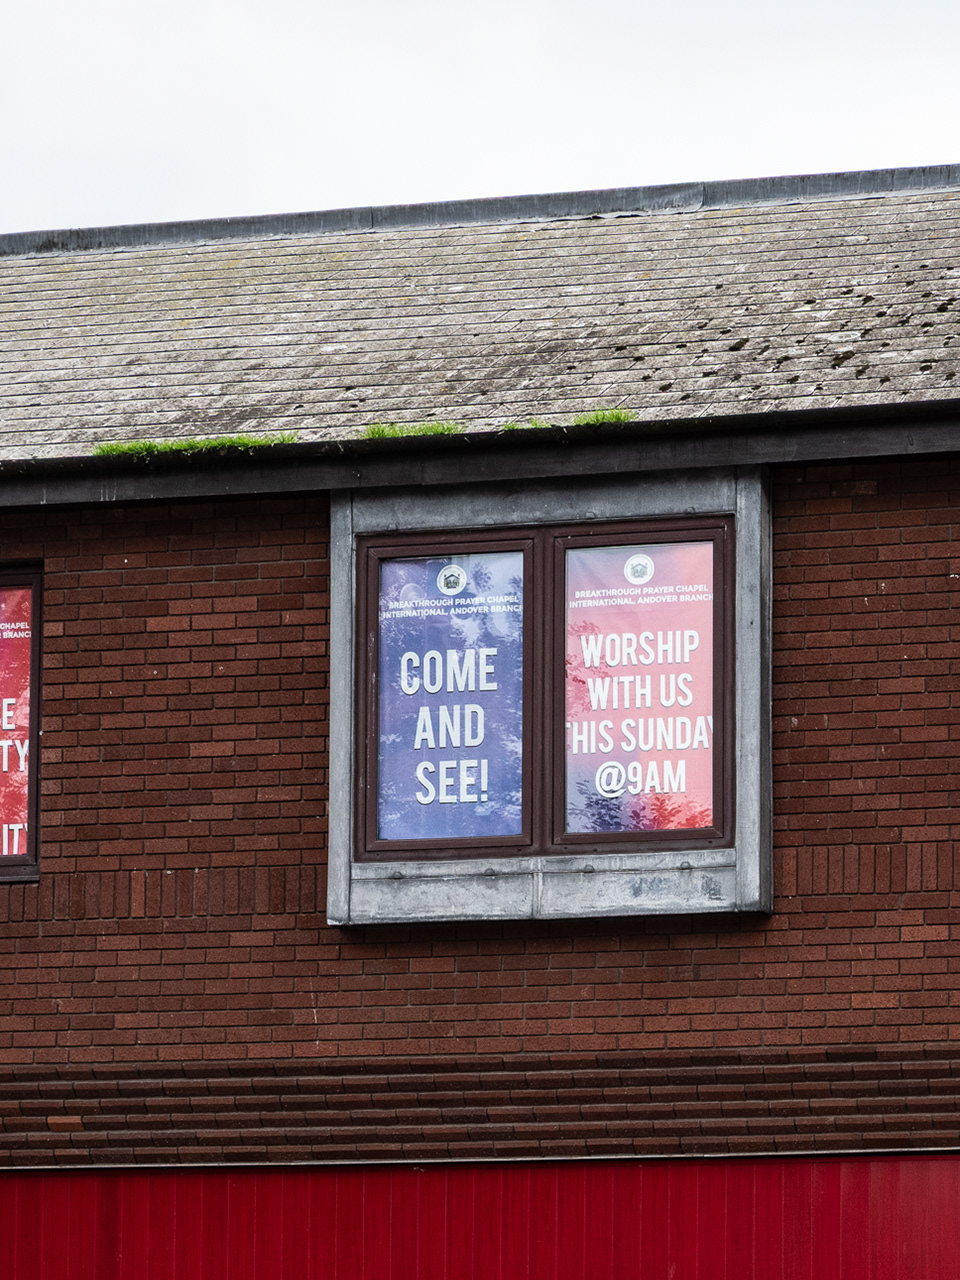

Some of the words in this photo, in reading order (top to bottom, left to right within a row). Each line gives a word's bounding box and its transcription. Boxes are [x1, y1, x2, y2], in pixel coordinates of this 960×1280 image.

[581, 630, 699, 669] WORSHIP
[400, 648, 498, 695] COME
[588, 674, 651, 711] WITH
[659, 673, 693, 707] US
[414, 704, 485, 750] AND
[416, 759, 488, 805] SEE!
[595, 760, 686, 798] @9AM
